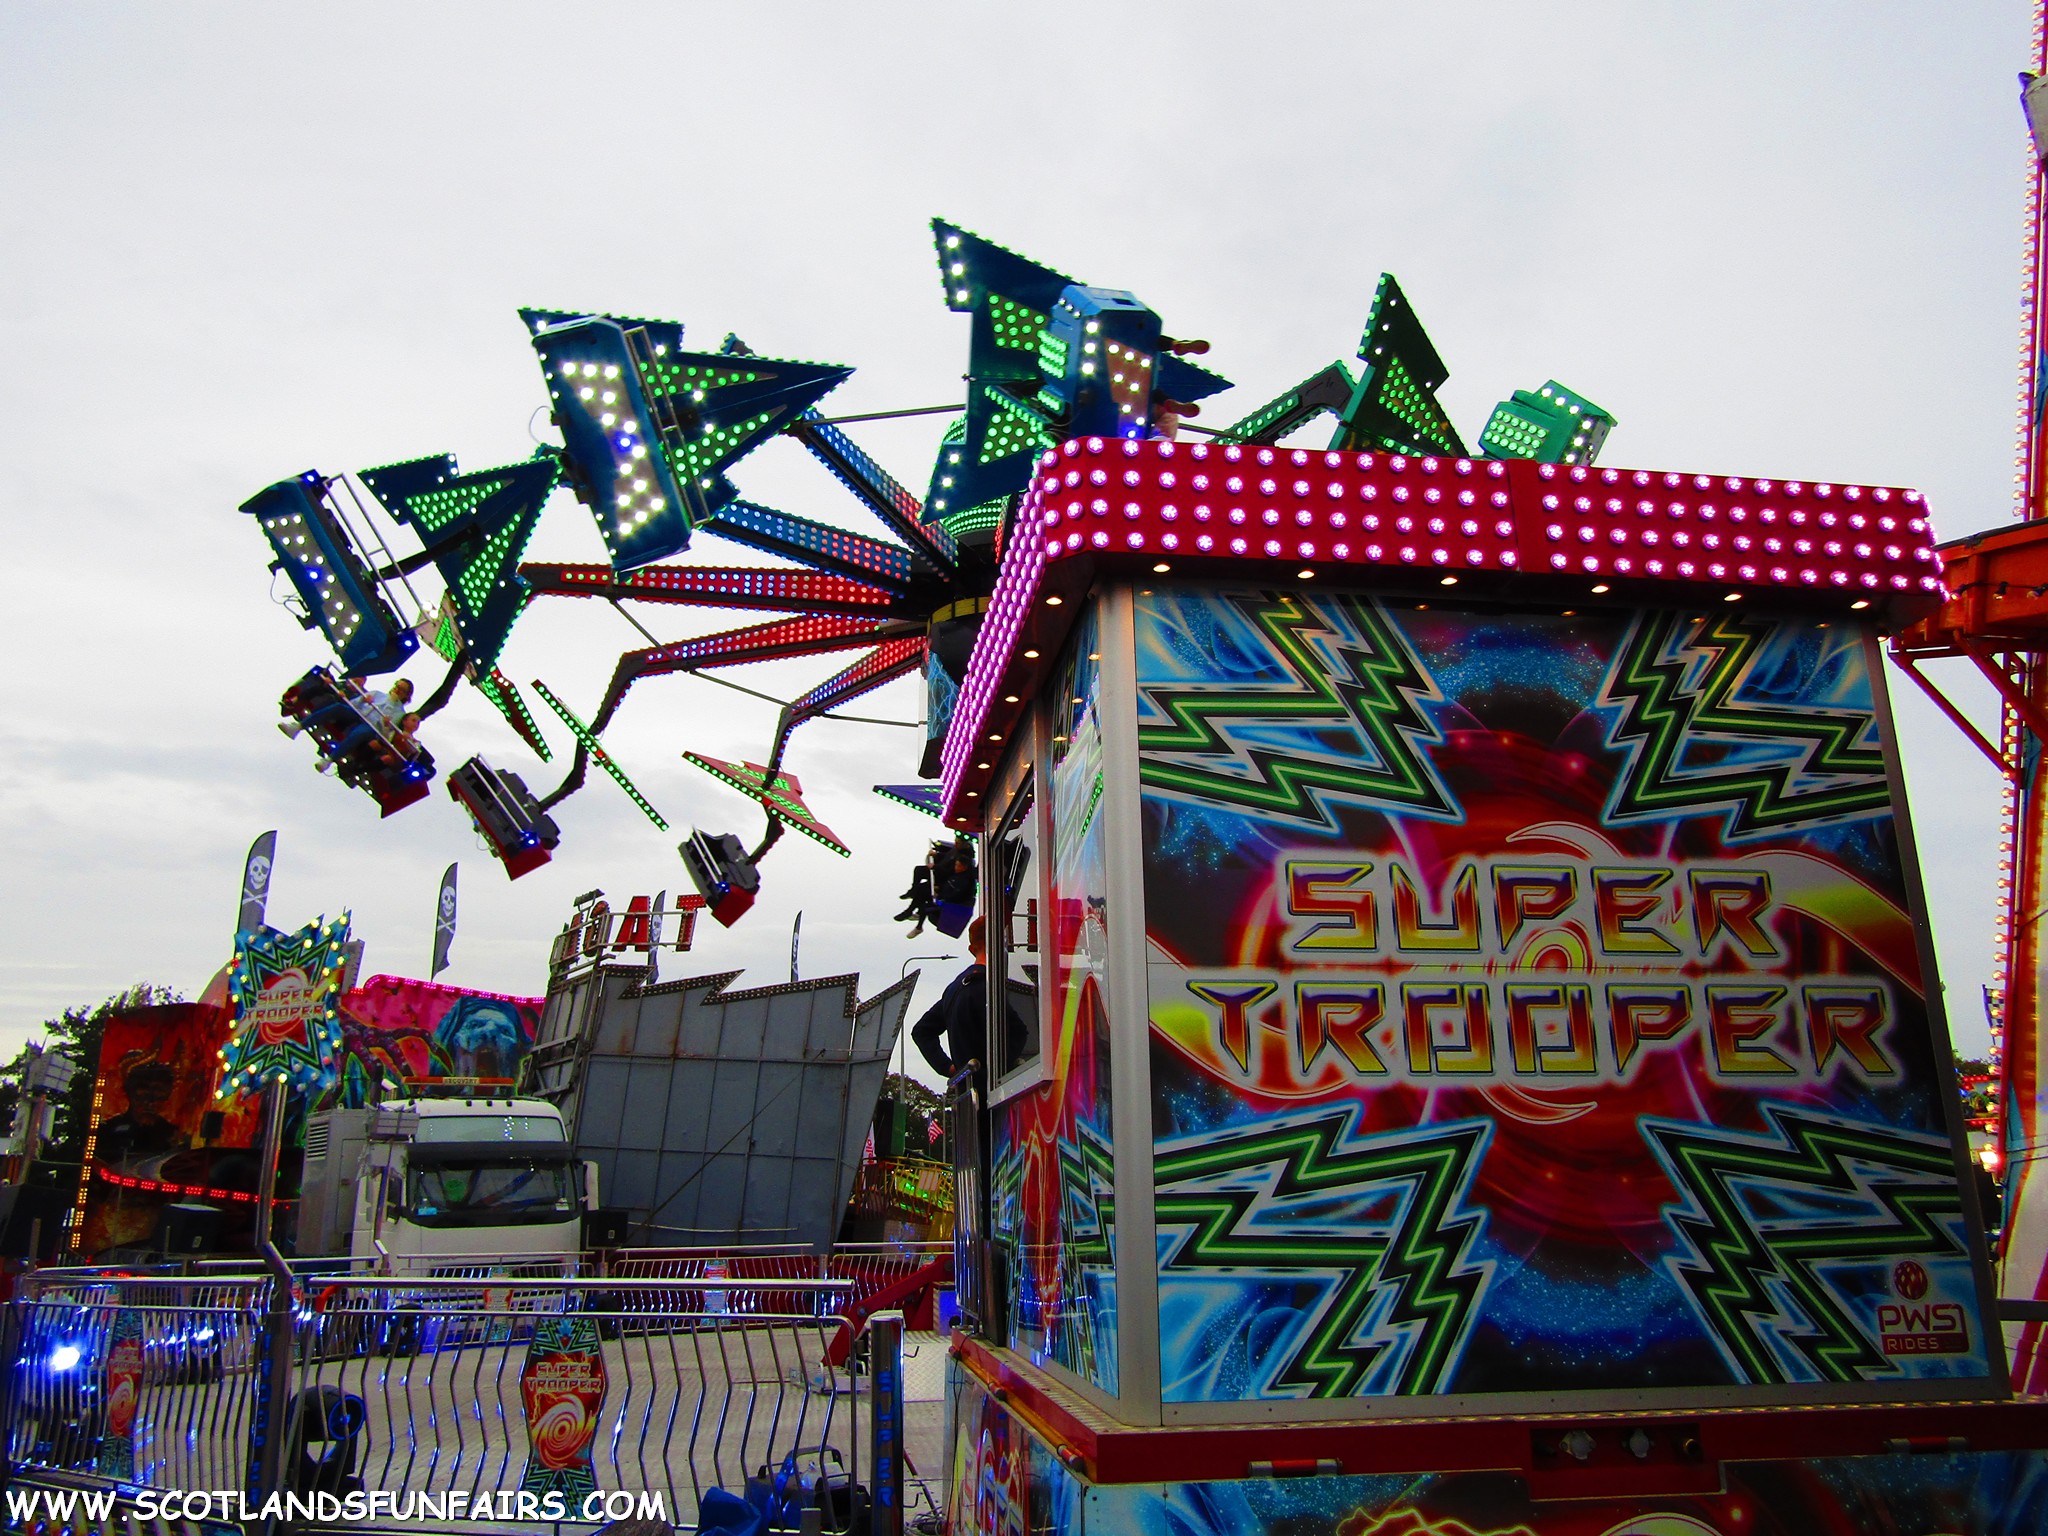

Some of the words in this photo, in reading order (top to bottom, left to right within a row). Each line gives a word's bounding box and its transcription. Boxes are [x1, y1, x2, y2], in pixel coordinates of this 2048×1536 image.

[1286, 860, 1780, 956] SUPER
[257, 988, 315, 1004] SUPER
[246, 1004, 324, 1021] TROOPER
[1187, 979, 1895, 1075] TROOPER
[1878, 1304, 1957, 1332] PWS
[1888, 1338, 1939, 1350] RIDES
[538, 1363, 591, 1377] SUPER
[527, 1377, 601, 1393] TROOPER
